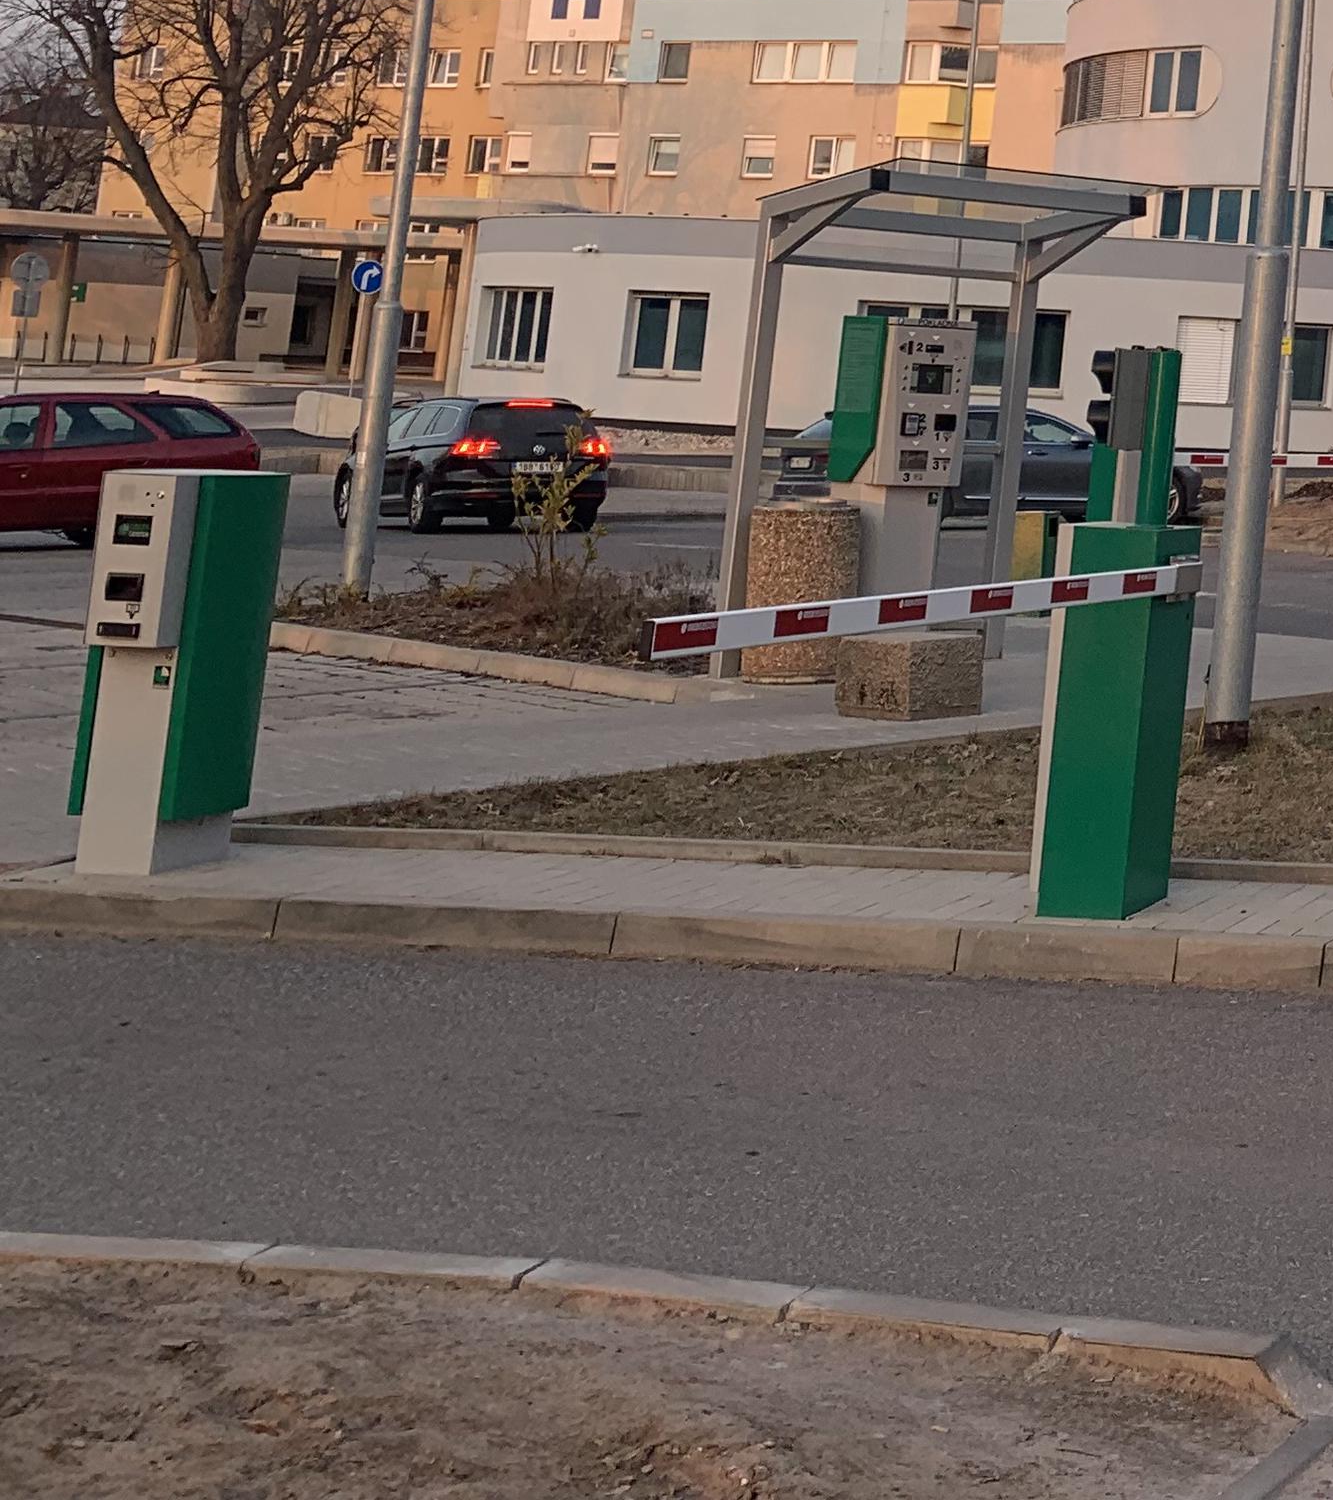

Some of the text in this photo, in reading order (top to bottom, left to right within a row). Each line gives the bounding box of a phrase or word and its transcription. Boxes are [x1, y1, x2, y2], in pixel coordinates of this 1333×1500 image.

[916, 342, 923, 352] 2
[919, 413, 926, 422] 2
[935, 432, 940, 441] 1
[932, 461, 939, 470] 3
[902, 473, 910, 482] 3
